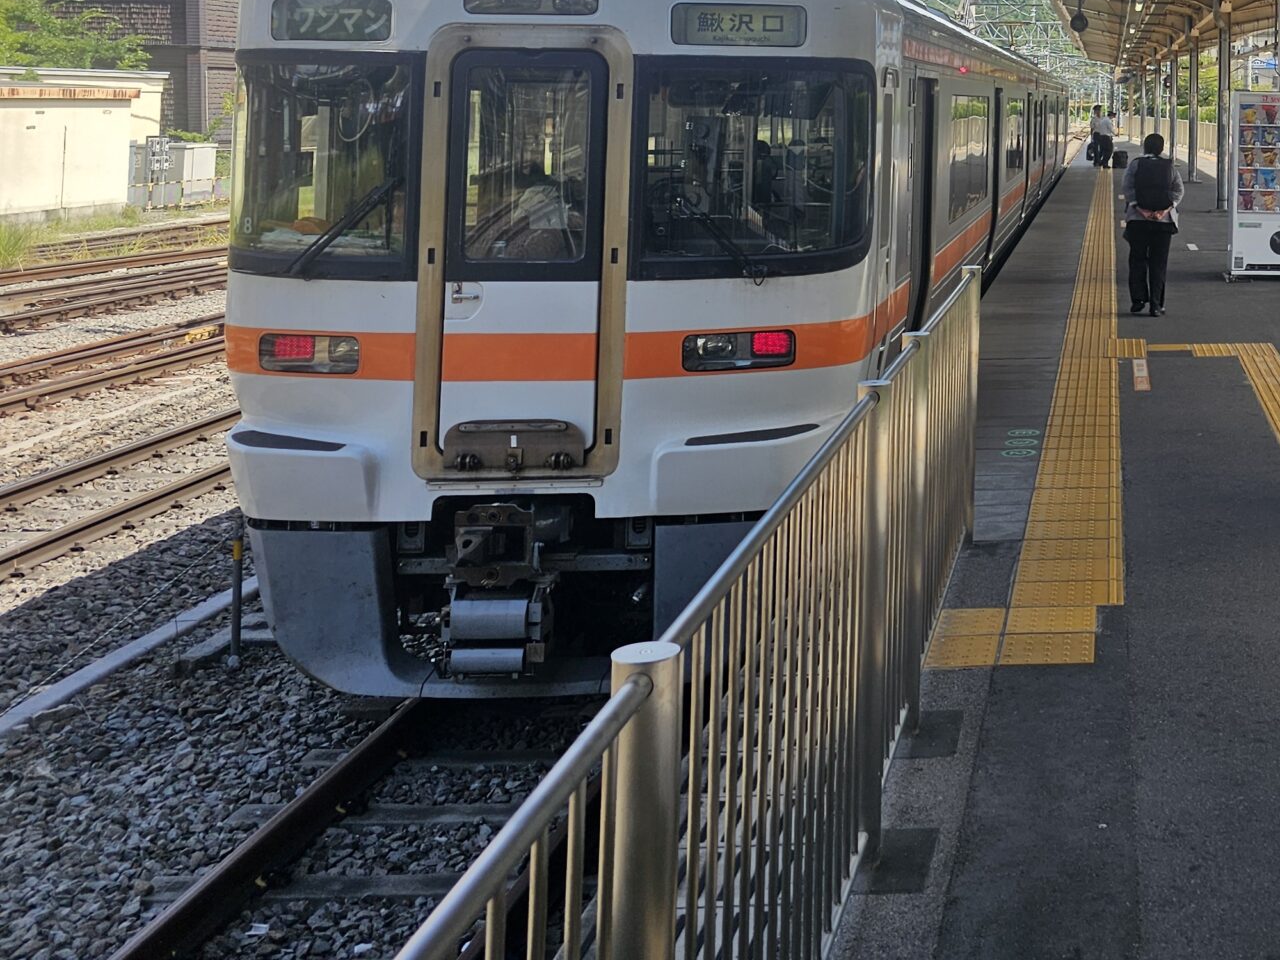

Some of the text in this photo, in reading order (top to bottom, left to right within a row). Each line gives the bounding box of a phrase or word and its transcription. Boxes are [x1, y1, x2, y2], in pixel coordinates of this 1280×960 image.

[294, 7, 388, 34] ワンマン
[697, 12, 785, 33] 鰍沢口
